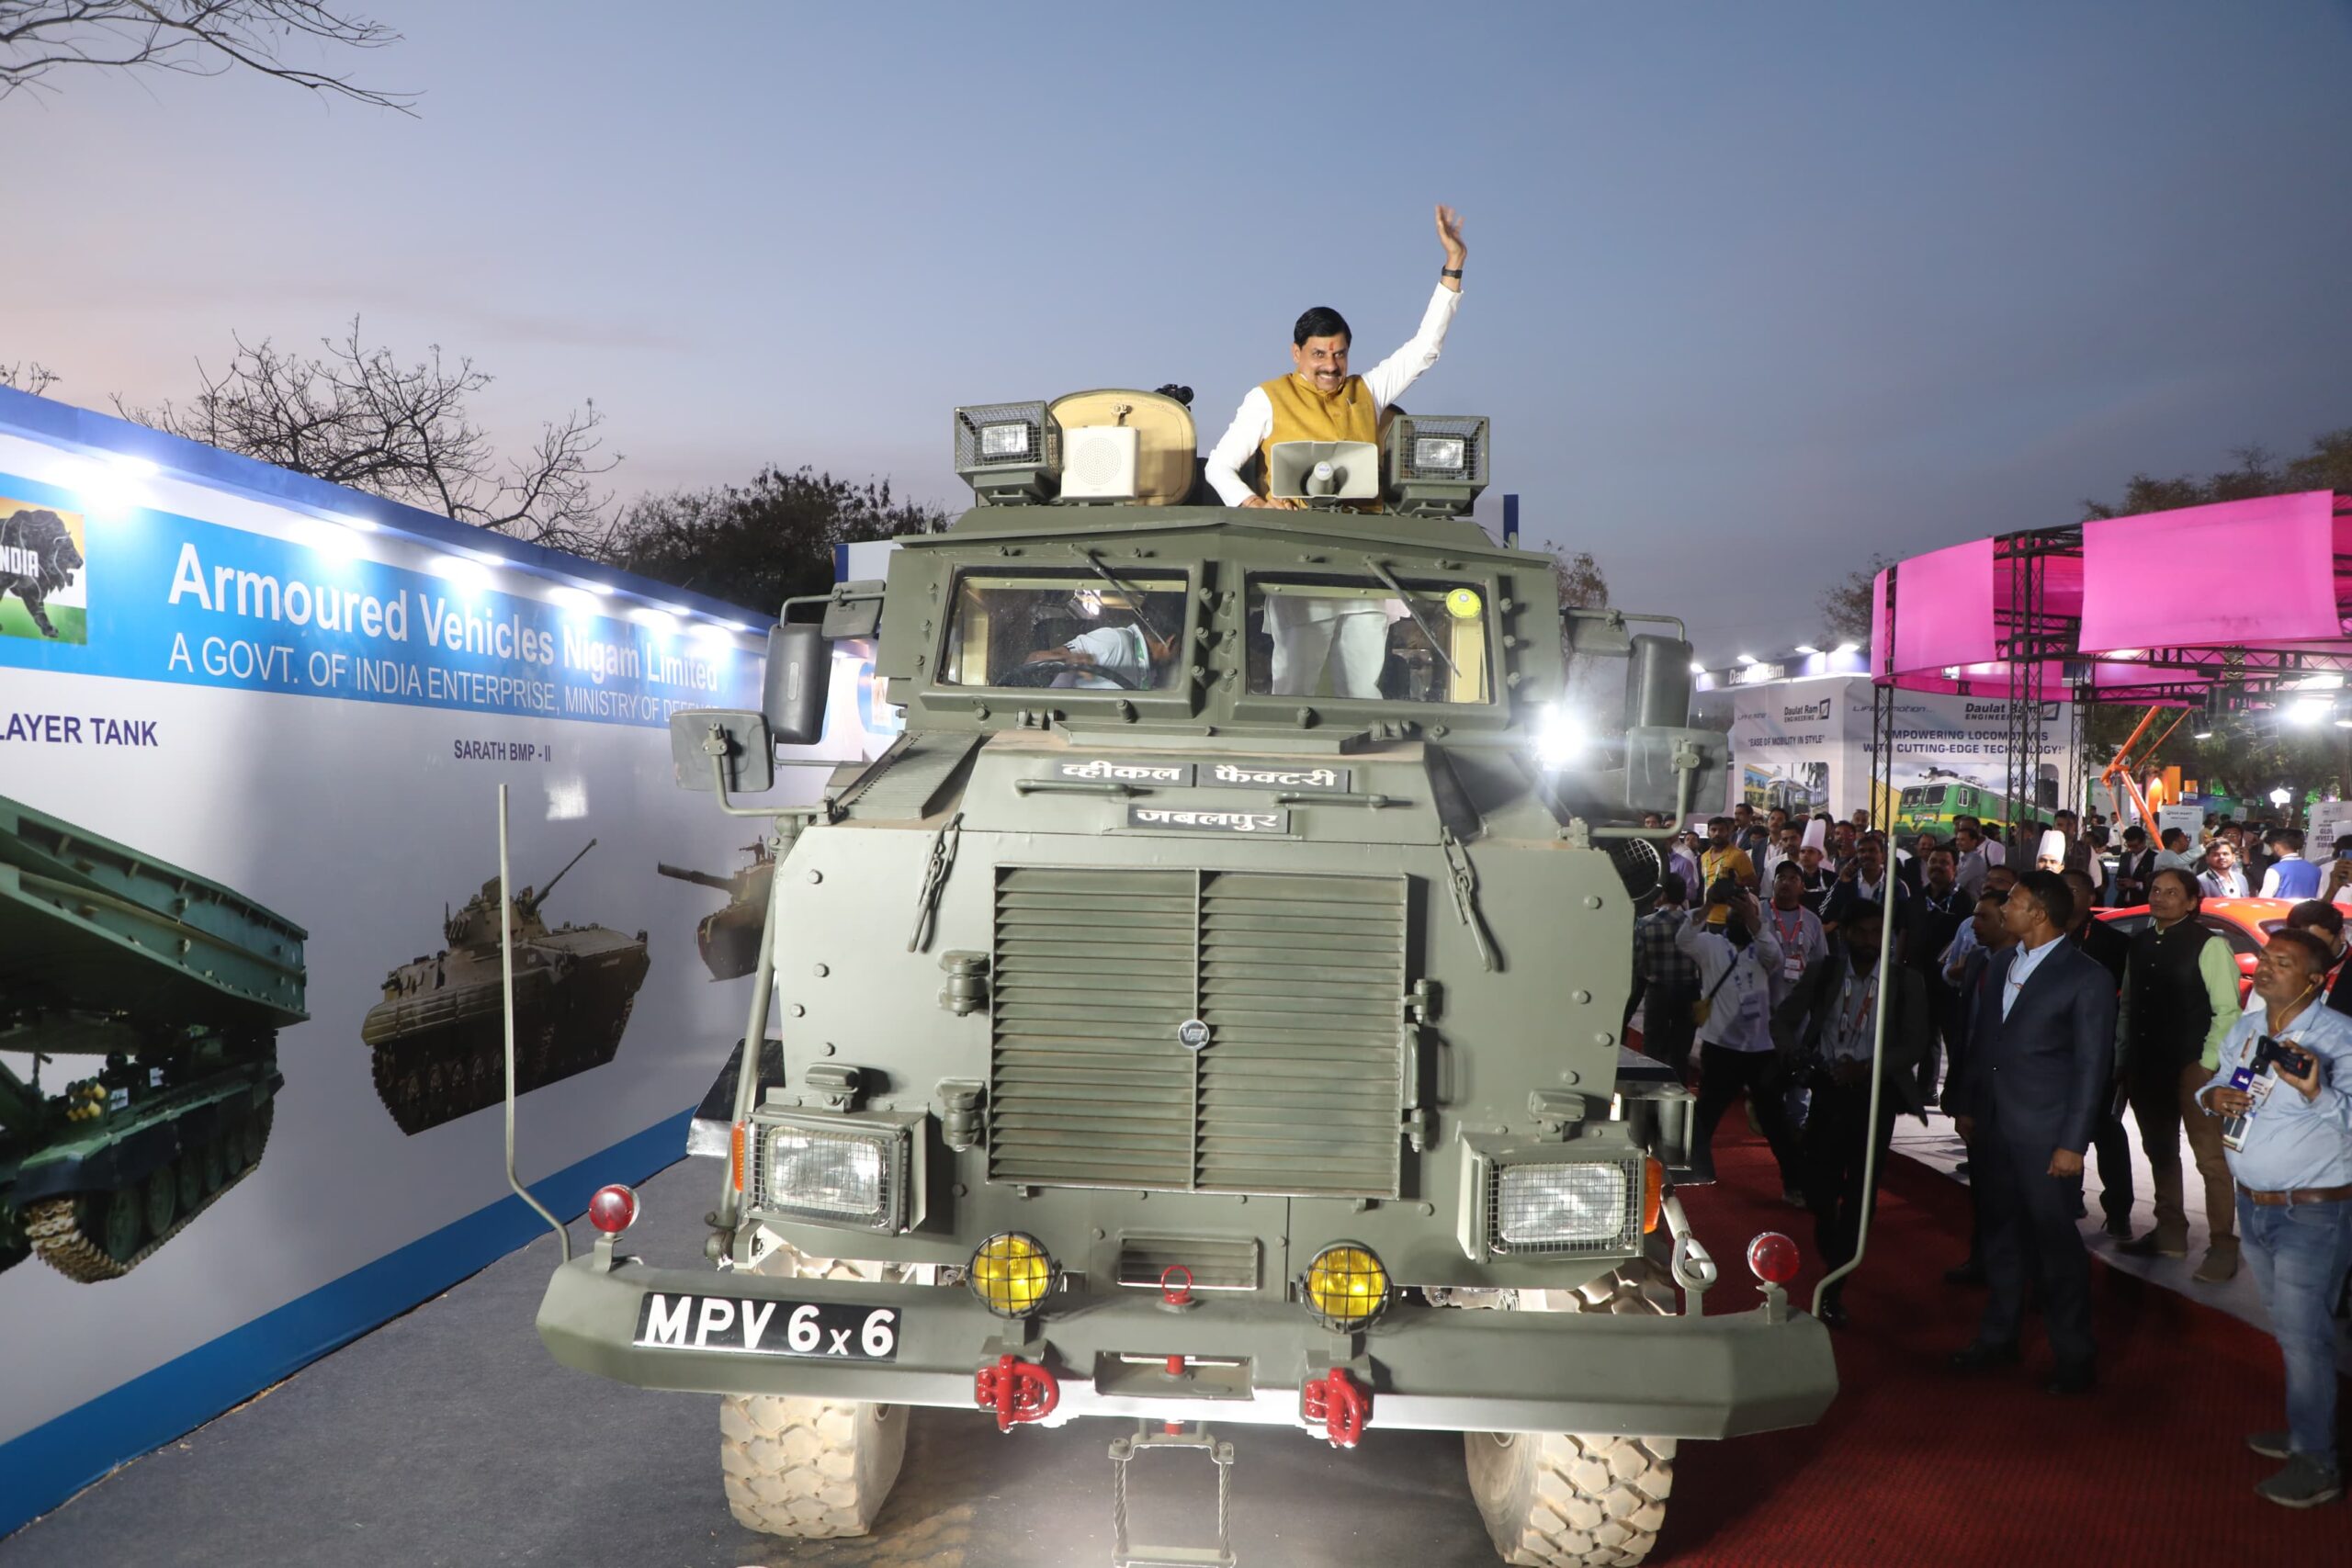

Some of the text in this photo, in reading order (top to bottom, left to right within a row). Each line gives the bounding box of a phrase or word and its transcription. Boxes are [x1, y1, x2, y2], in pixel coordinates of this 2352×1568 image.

[168, 542, 718, 692] Armoured Vehicles Nigam Limited
[168, 632, 194, 673] A
[202, 637, 299, 684] GOVT.
[309, 650, 347, 688] OF
[356, 657, 423, 697] INDIA
[428, 667, 560, 716] ENTERPRISE,
[565, 685, 639, 720] MINISTRY
[641, 695, 660, 721] OF
[1965, 703, 2006, 714] Daulat
[0, 713, 159, 748] AYER TANK
[454, 739, 506, 761] SARATH
[510, 743, 535, 762] BMP
[1896, 743, 1979, 754] CUTTING-EDGE
[1061, 761, 1184, 781] व्हीकल
[1136, 809, 1279, 831] जबलपुर
[644, 1294, 776, 1349] MPV
